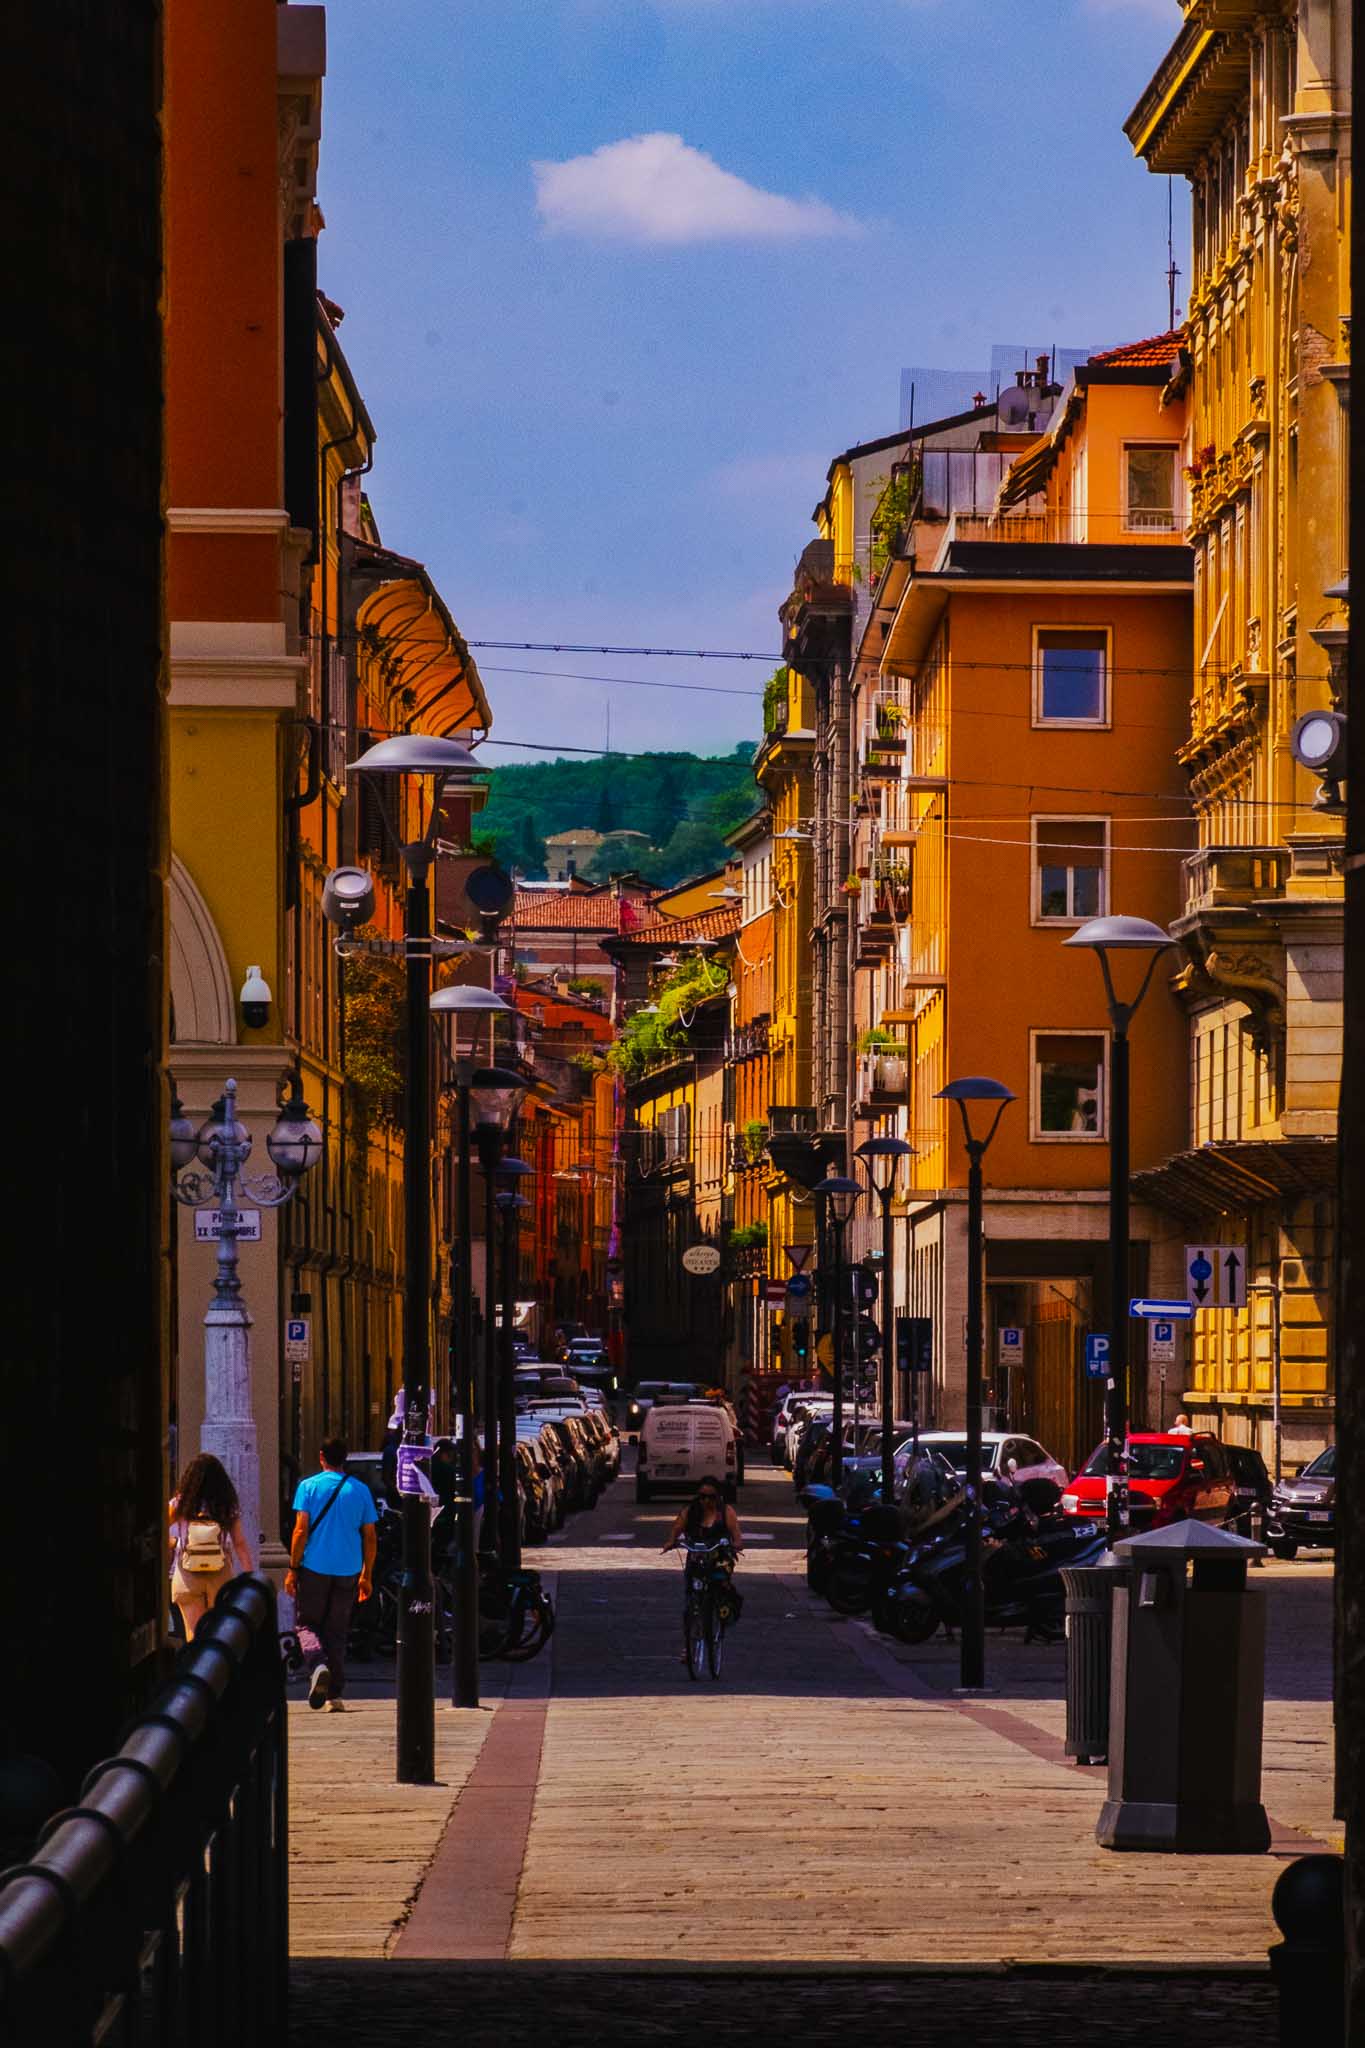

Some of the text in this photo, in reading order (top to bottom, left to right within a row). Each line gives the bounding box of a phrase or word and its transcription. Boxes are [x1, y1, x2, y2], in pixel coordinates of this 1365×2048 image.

[292, 1325, 302, 1337] P
[1159, 1326, 1169, 1338] P
[1008, 1332, 1017, 1343] P
[1094, 1338, 1109, 1358] P
